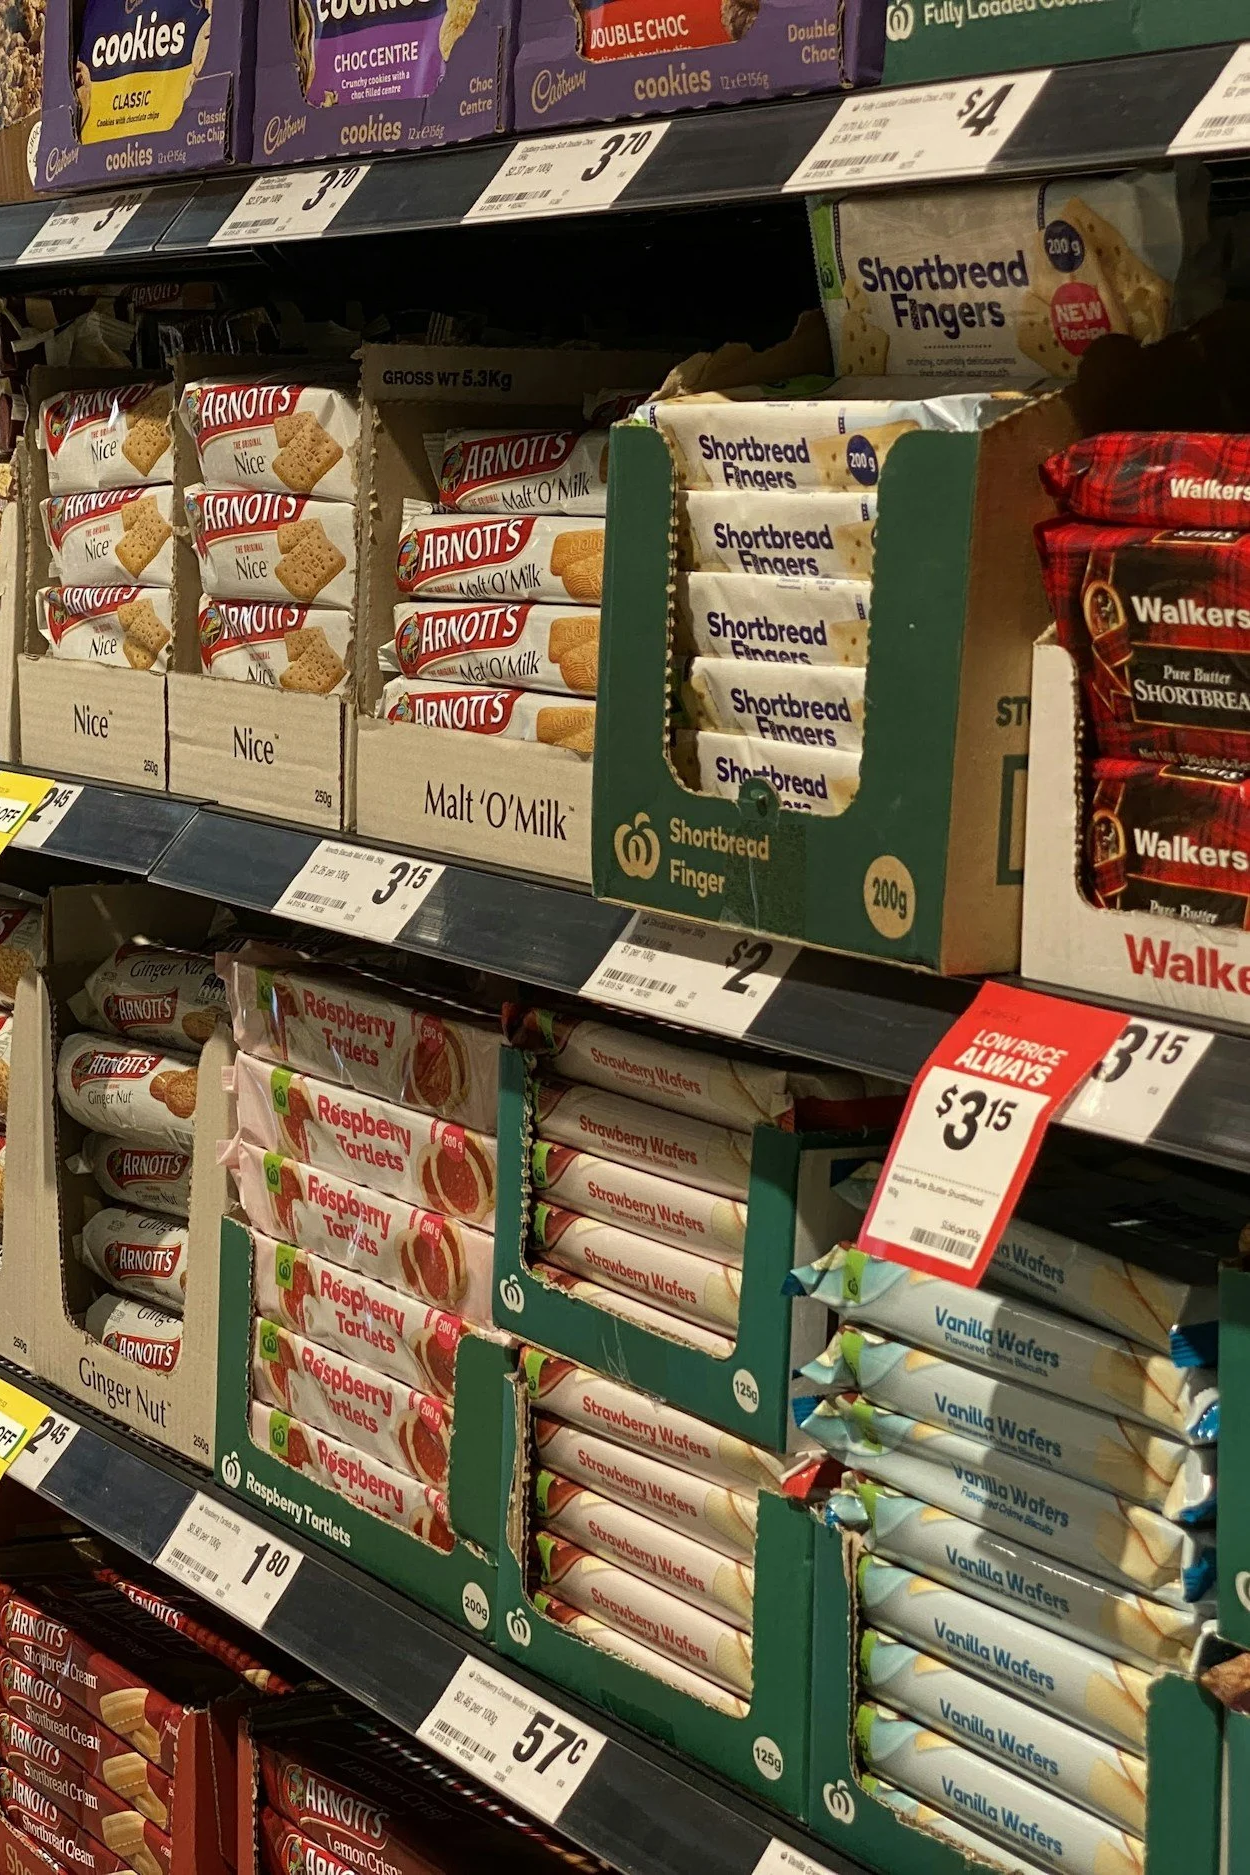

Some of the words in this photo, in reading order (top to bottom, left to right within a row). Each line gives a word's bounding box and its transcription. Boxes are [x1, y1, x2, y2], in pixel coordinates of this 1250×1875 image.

[590, 21, 645, 50] DOUBLE
[645, 13, 689, 39] CHOC
[788, 20, 835, 44] Double
[924, 1, 964, 28] Fully
[92, 11, 185, 68] cookies
[334, 50, 367, 73] CHOC
[369, 41, 419, 67] CENTRE
[801, 44, 836, 64] Choc
[341, 78, 367, 89] Crunchy
[368, 74, 391, 85] cookies
[392, 72, 405, 82] with
[351, 90, 364, 100] choc
[365, 87, 381, 98] filled
[382, 85, 401, 95] centre
[470, 76, 493, 93] Choc
[531, 68, 586, 114] Cadbury
[634, 62, 711, 101] cookies
[113, 90, 151, 111] CLASSIC
[198, 108, 225, 125] Classic
[460, 98, 492, 117] Centre
[956, 83, 1015, 137] $4
[97, 117, 114, 128] Cookies
[115, 116, 125, 125] with
[187, 131, 205, 146] Choc
[207, 127, 224, 143] Chip
[264, 115, 306, 155] Cadbury
[341, 114, 402, 145] cookies
[858, 250, 1029, 292] Shortbread
[890, 294, 1005, 340] Fingers
[1056, 301, 1102, 323] NEW
[383, 370, 434, 386] GROSS
[437, 371, 459, 386] WT
[462, 370, 512, 391] 5.3Kg
[200, 387, 292, 428] ARNOTT'S
[234, 450, 265, 476] Nice
[698, 434, 810, 465] Shortbread
[723, 462, 797, 491] Fingers
[1170, 478, 1250, 501] Walkers
[203, 496, 297, 532] ARNOTT'S
[420, 518, 524, 572] ARNOTT'S
[235, 556, 268, 580] Nice
[1131, 595, 1250, 630] Walkers
[1164, 665, 1189, 681] Pure
[1194, 668, 1231, 685] Butter
[74, 704, 108, 738] Nice
[730, 687, 852, 723] Shortbread
[233, 726, 274, 765] Nice
[314, 790, 332, 807] 250g
[425, 781, 475, 823] Malt
[669, 816, 769, 861] Shortbread
[1133, 828, 1248, 871] Walkers
[669, 860, 725, 897] Finger
[872, 875, 908, 919] 200g
[722, 939, 774, 994] $2
[88, 1053, 155, 1074] ARNOTT'S
[972, 1029, 1016, 1053] LOW
[1014, 1040, 1069, 1066] PRICE
[954, 1047, 1052, 1086] ALWAYS
[88, 1090, 114, 1106] Ginger
[116, 1090, 132, 1104] Nut
[318, 1094, 411, 1156] Raspberry
[336, 1133, 404, 1172] Tartlets
[119, 1248, 173, 1272] ARNOTT'S
[584, 1247, 650, 1290] Strawberry
[650, 1270, 698, 1304] Wafers
[934, 1305, 994, 1345] Vanilla
[998, 1329, 1060, 1369] Wafers
[78, 1357, 131, 1409] Ginger
[135, 1386, 166, 1428] Nut
[734, 1379, 758, 1402] 125g
[193, 1434, 209, 1455] 250g
[582, 1395, 657, 1441] Strawberry
[657, 1423, 712, 1460] Wafers
[246, 1471, 304, 1525] Raspberry
[304, 1508, 352, 1548] Tartlets
[464, 1595, 488, 1620] 200g
[11, 1608, 68, 1648] ARNOTT'S
[305, 1775, 390, 1839] ARNOTT'S
[941, 1775, 999, 1824] Vanilla
[1000, 1804, 1064, 1857] Wafers
[22, 1815, 66, 1850] Shortbread
[326, 1832, 367, 1867] Lemon
